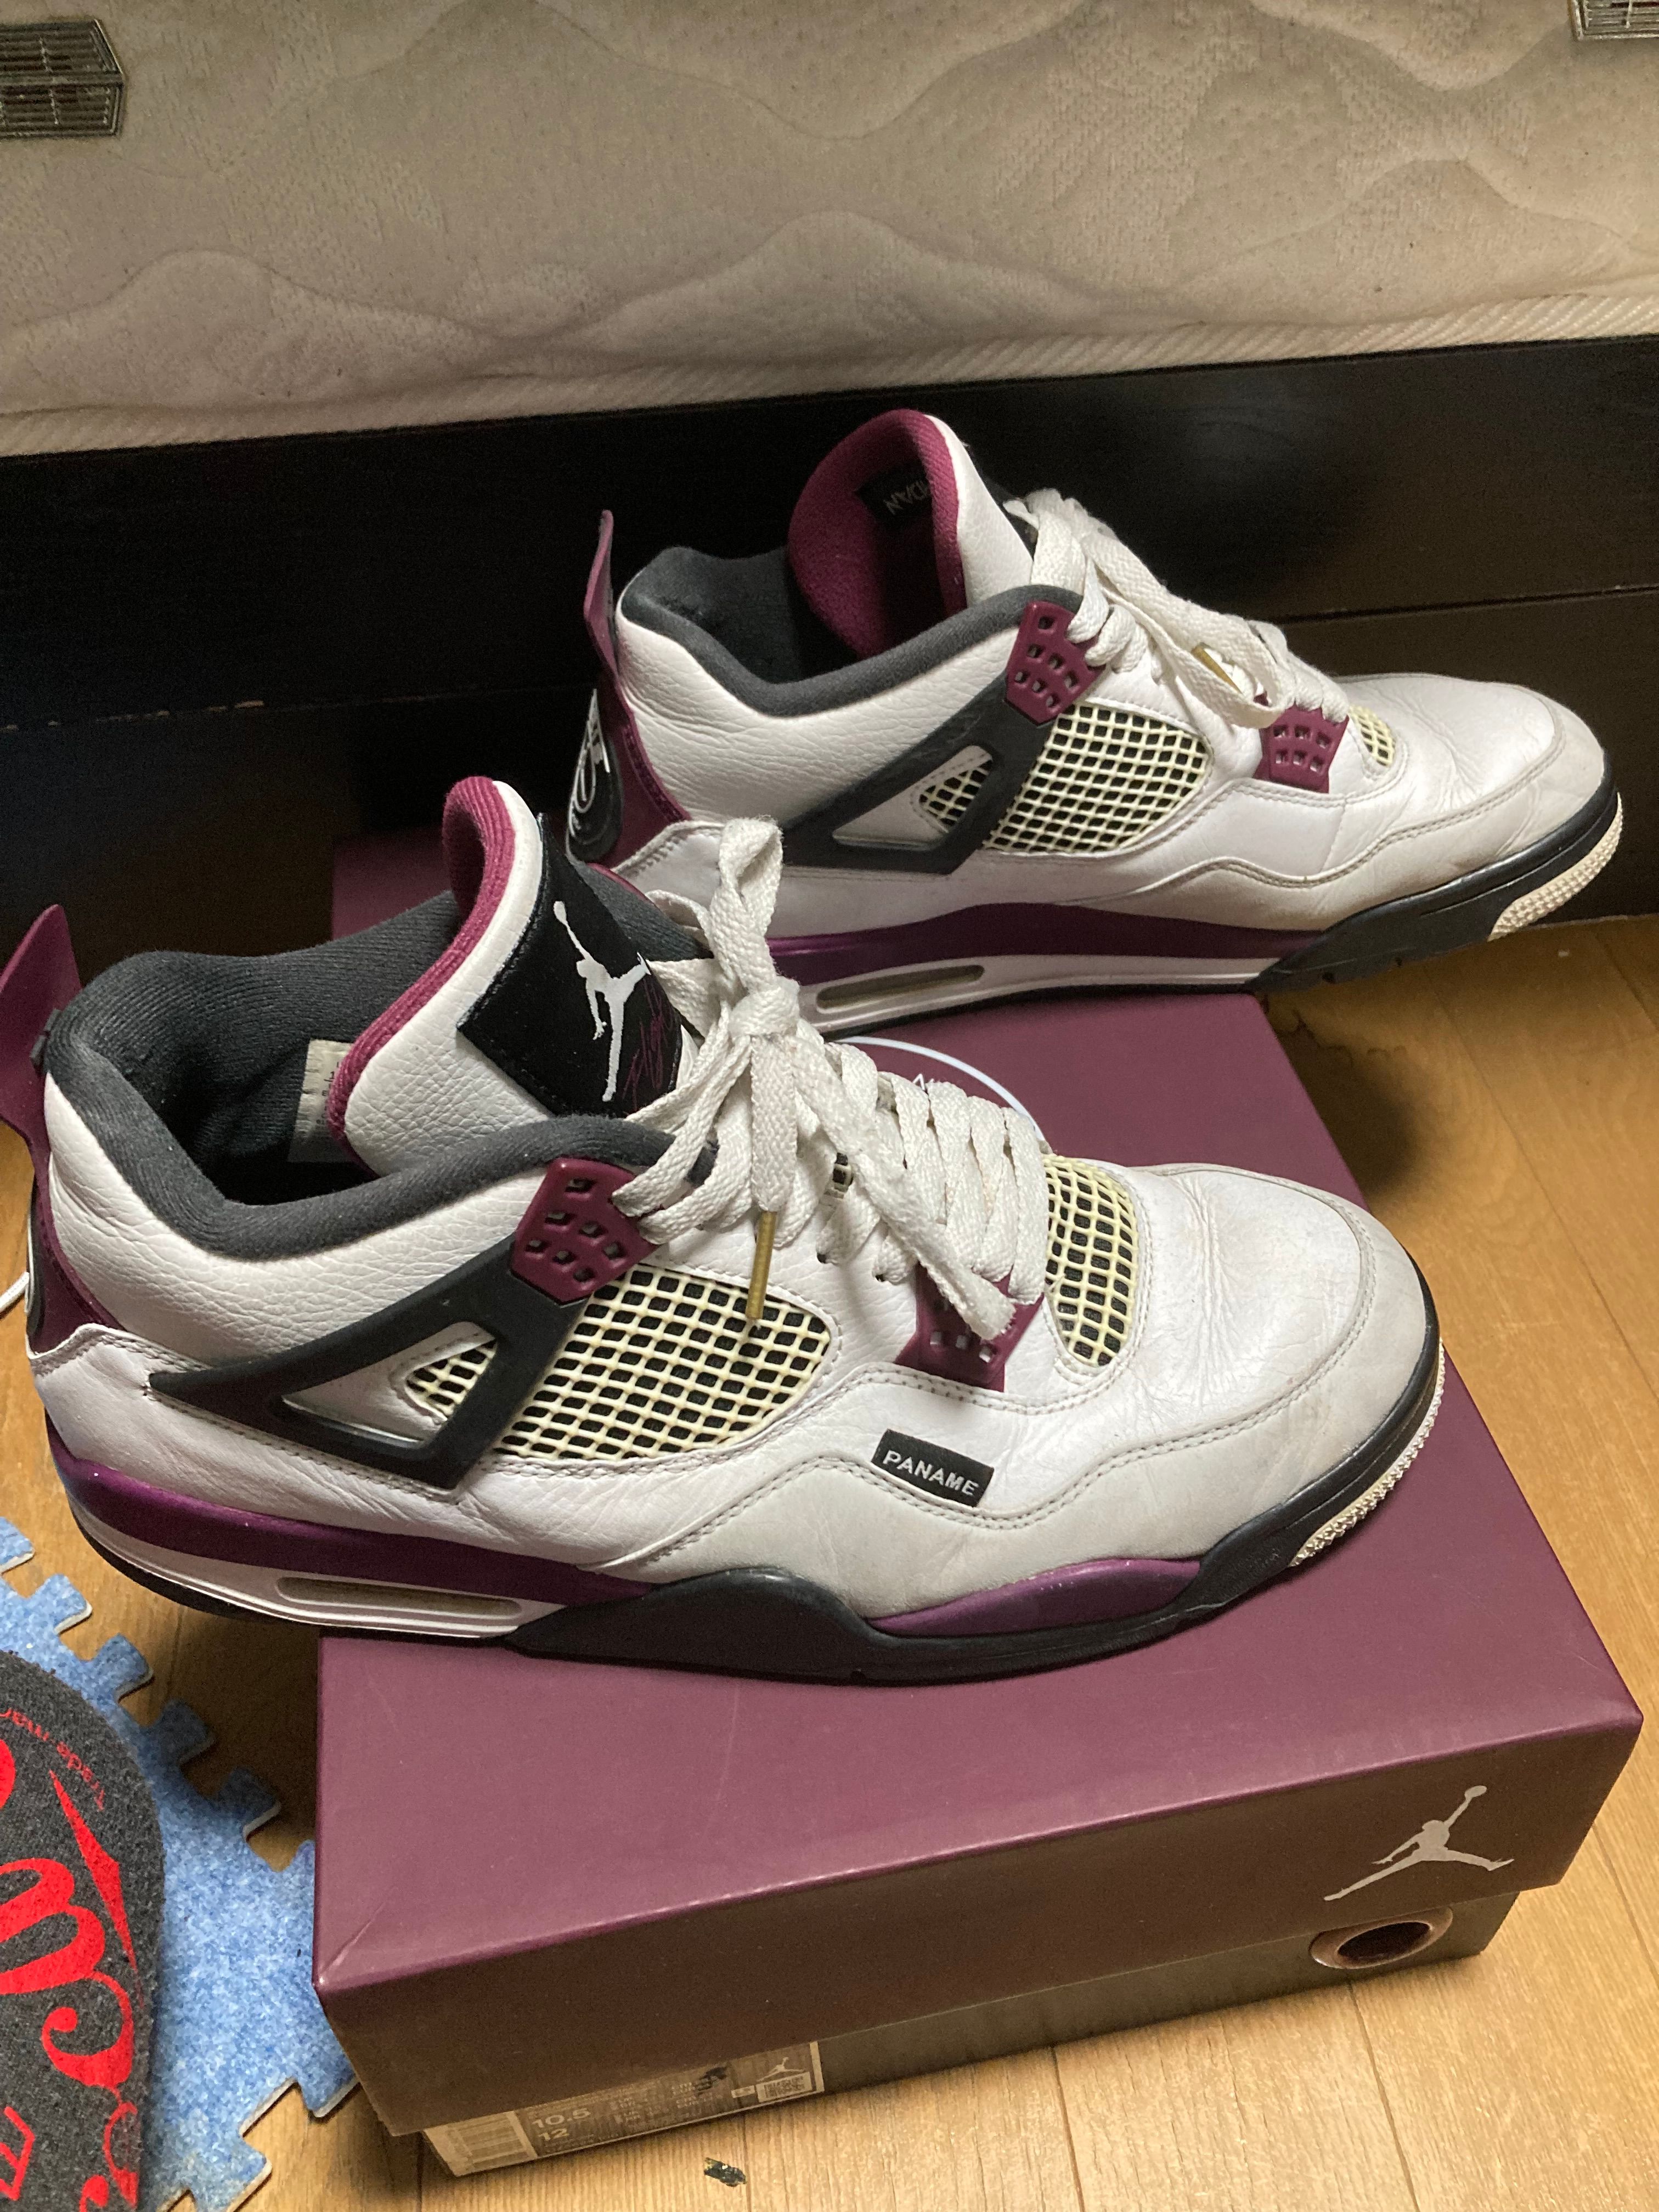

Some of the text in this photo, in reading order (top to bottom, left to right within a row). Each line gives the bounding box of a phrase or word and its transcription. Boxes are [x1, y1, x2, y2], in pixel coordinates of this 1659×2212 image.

[882, 1449, 980, 1496] PANAME
[532, 2107, 591, 2128] 10.5
[538, 2128, 570, 2141] 12
